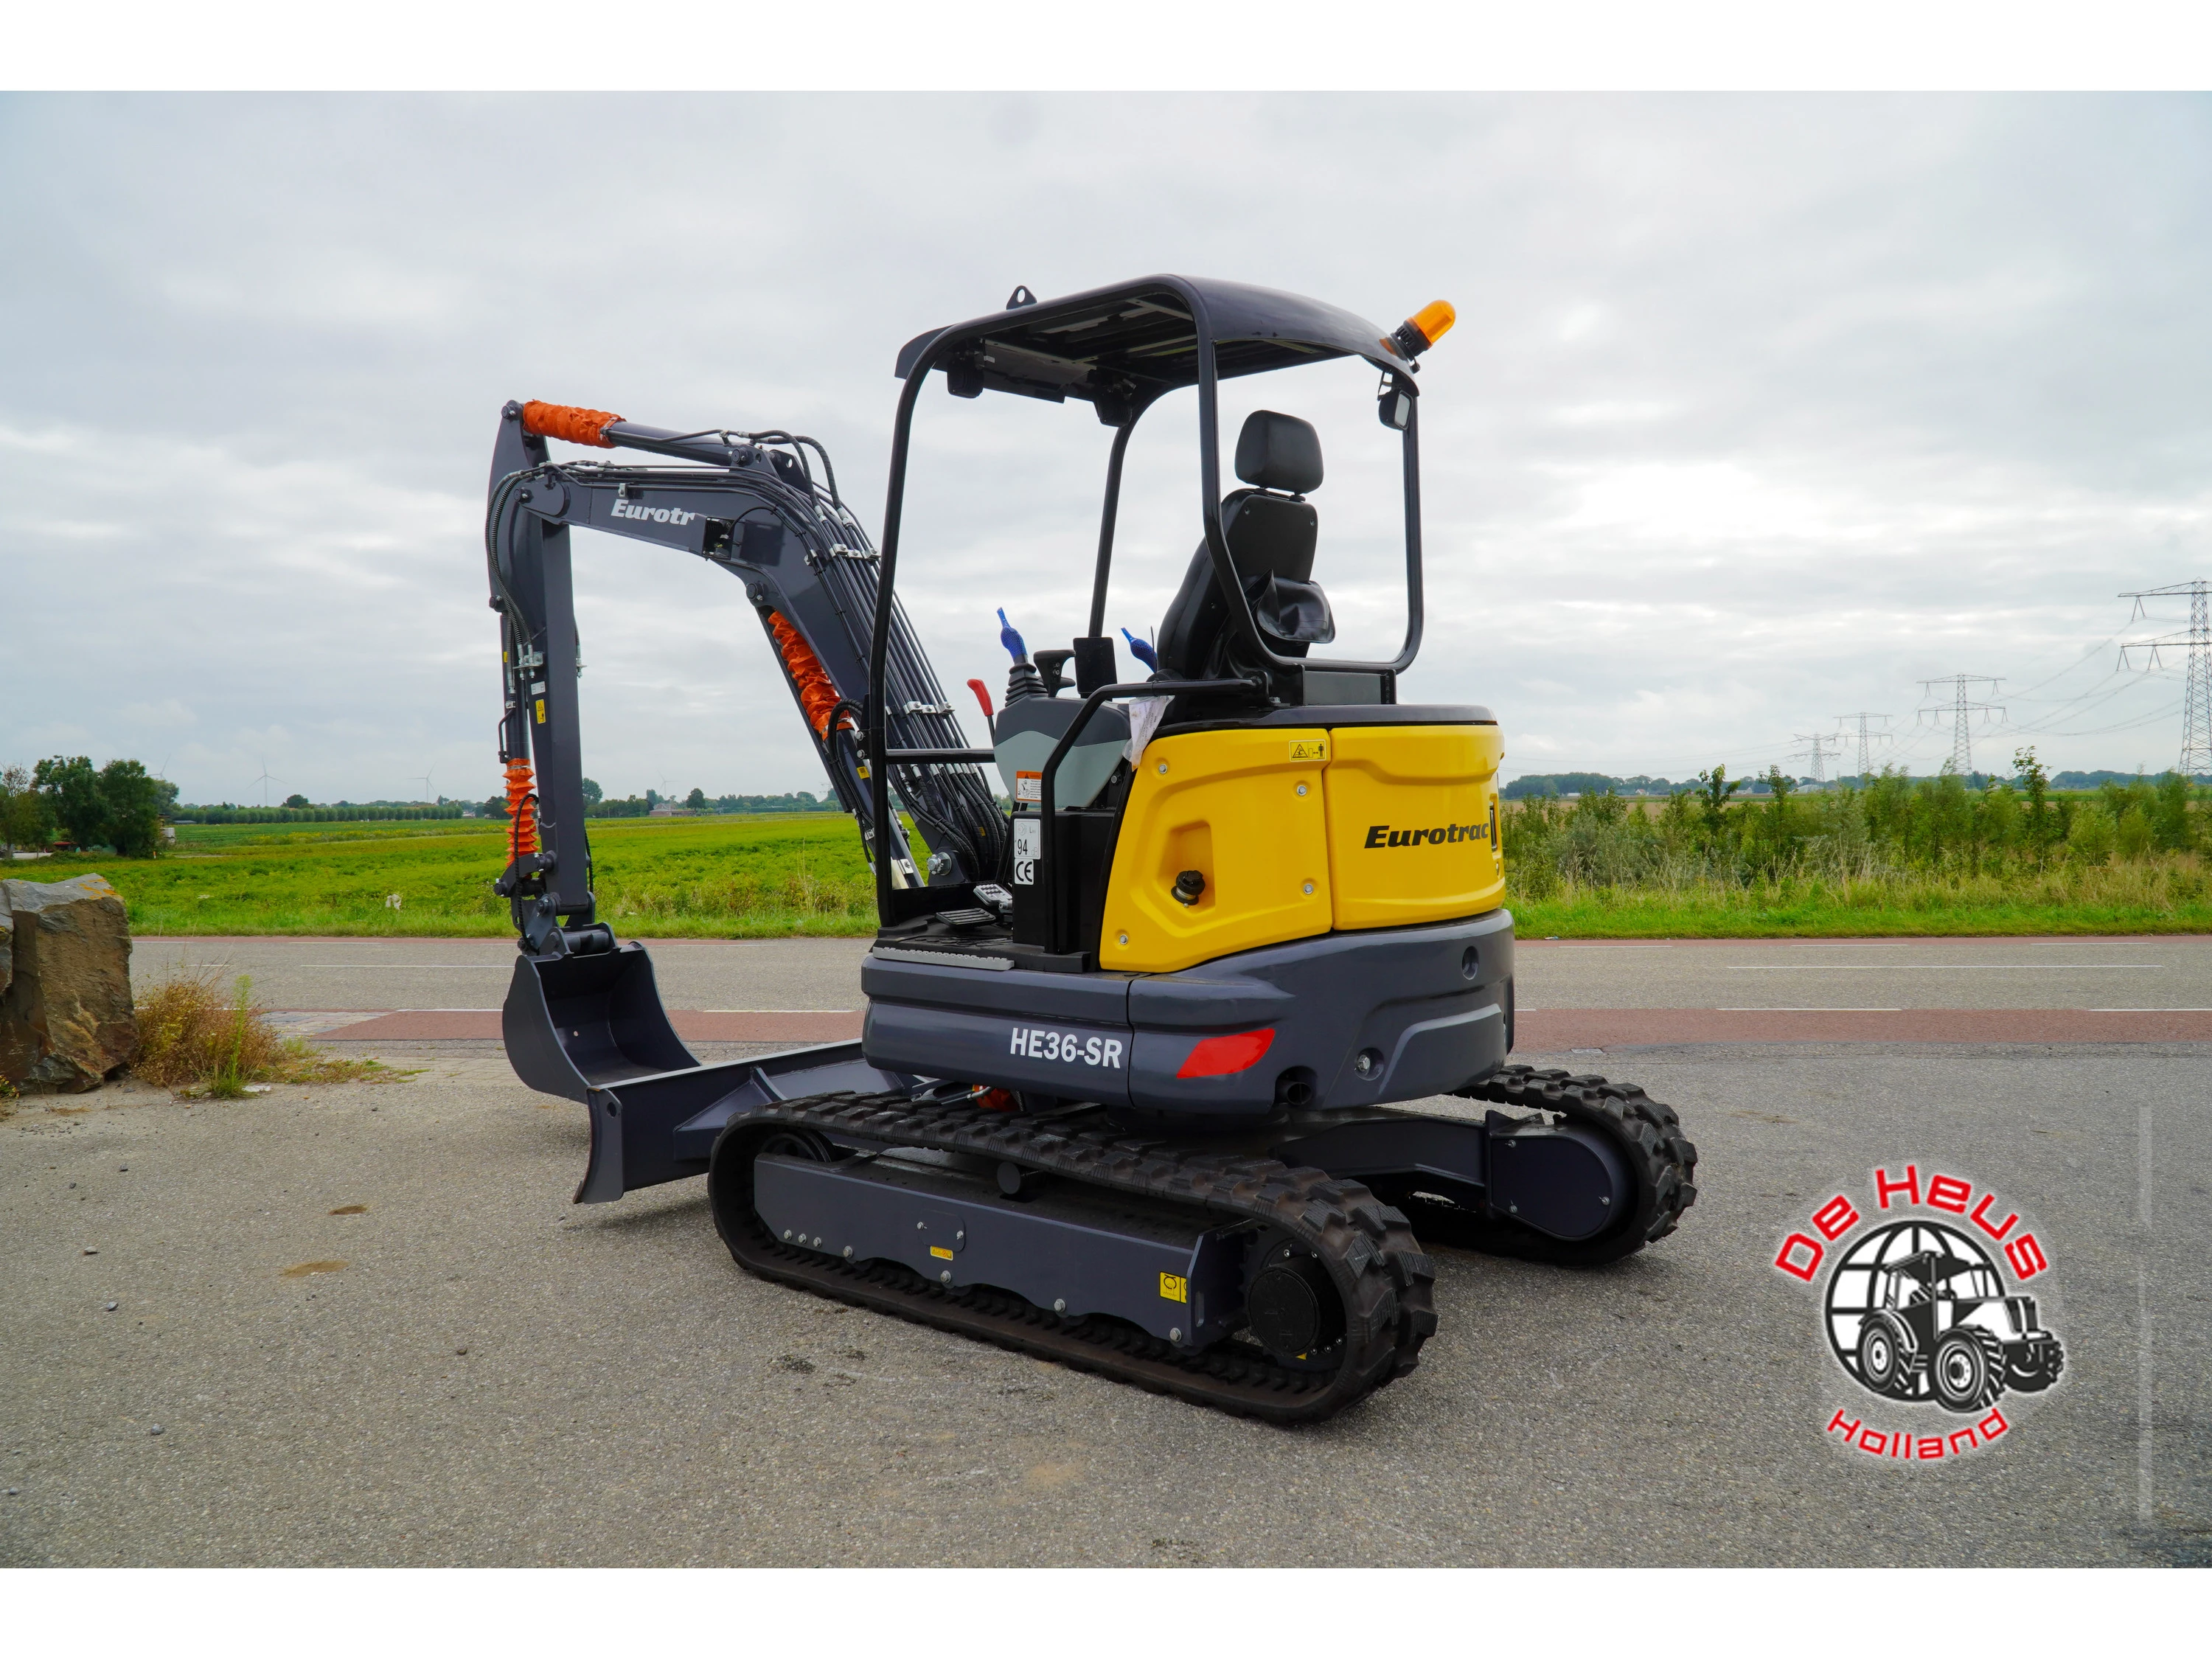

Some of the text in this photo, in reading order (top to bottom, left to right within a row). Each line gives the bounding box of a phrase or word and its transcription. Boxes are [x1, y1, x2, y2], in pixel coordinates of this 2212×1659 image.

[611, 498, 696, 526] Eurotr
[1018, 838, 1028, 855] 94
[1364, 823, 1489, 849] Eurotrac
[1015, 860, 1033, 883] CE
[1009, 1027, 1123, 1069] HE36-SR
